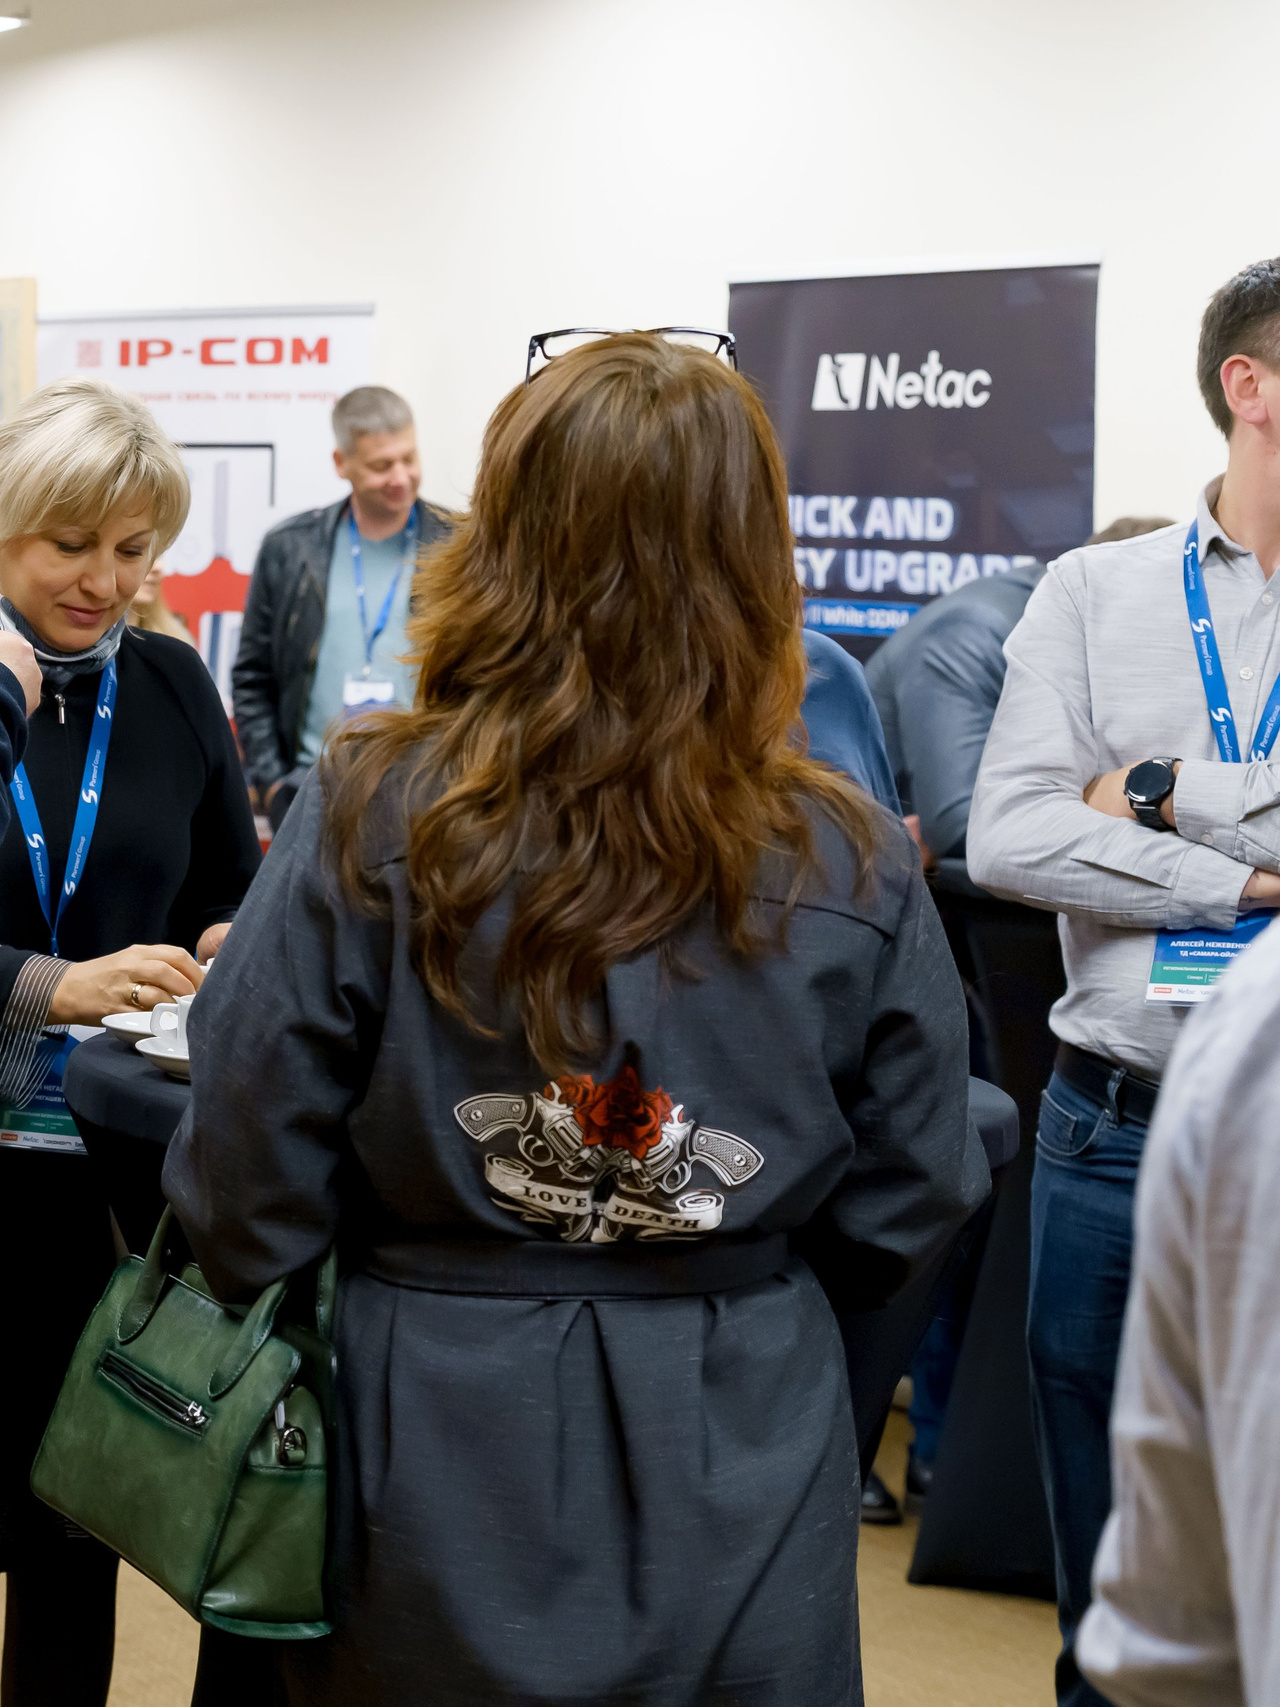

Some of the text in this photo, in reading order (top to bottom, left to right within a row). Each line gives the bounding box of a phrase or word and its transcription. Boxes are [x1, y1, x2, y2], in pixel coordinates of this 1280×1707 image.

[119, 336, 330, 367] IP-COM
[866, 350, 992, 410] Netac
[788, 495, 955, 541] ICK AND
[794, 547, 1036, 596] SY UPGRA
[1170, 939, 1204, 948] АЛЕКСЕЙ
[523, 1186, 588, 1208] LOVE
[612, 1205, 701, 1230] DEATH
